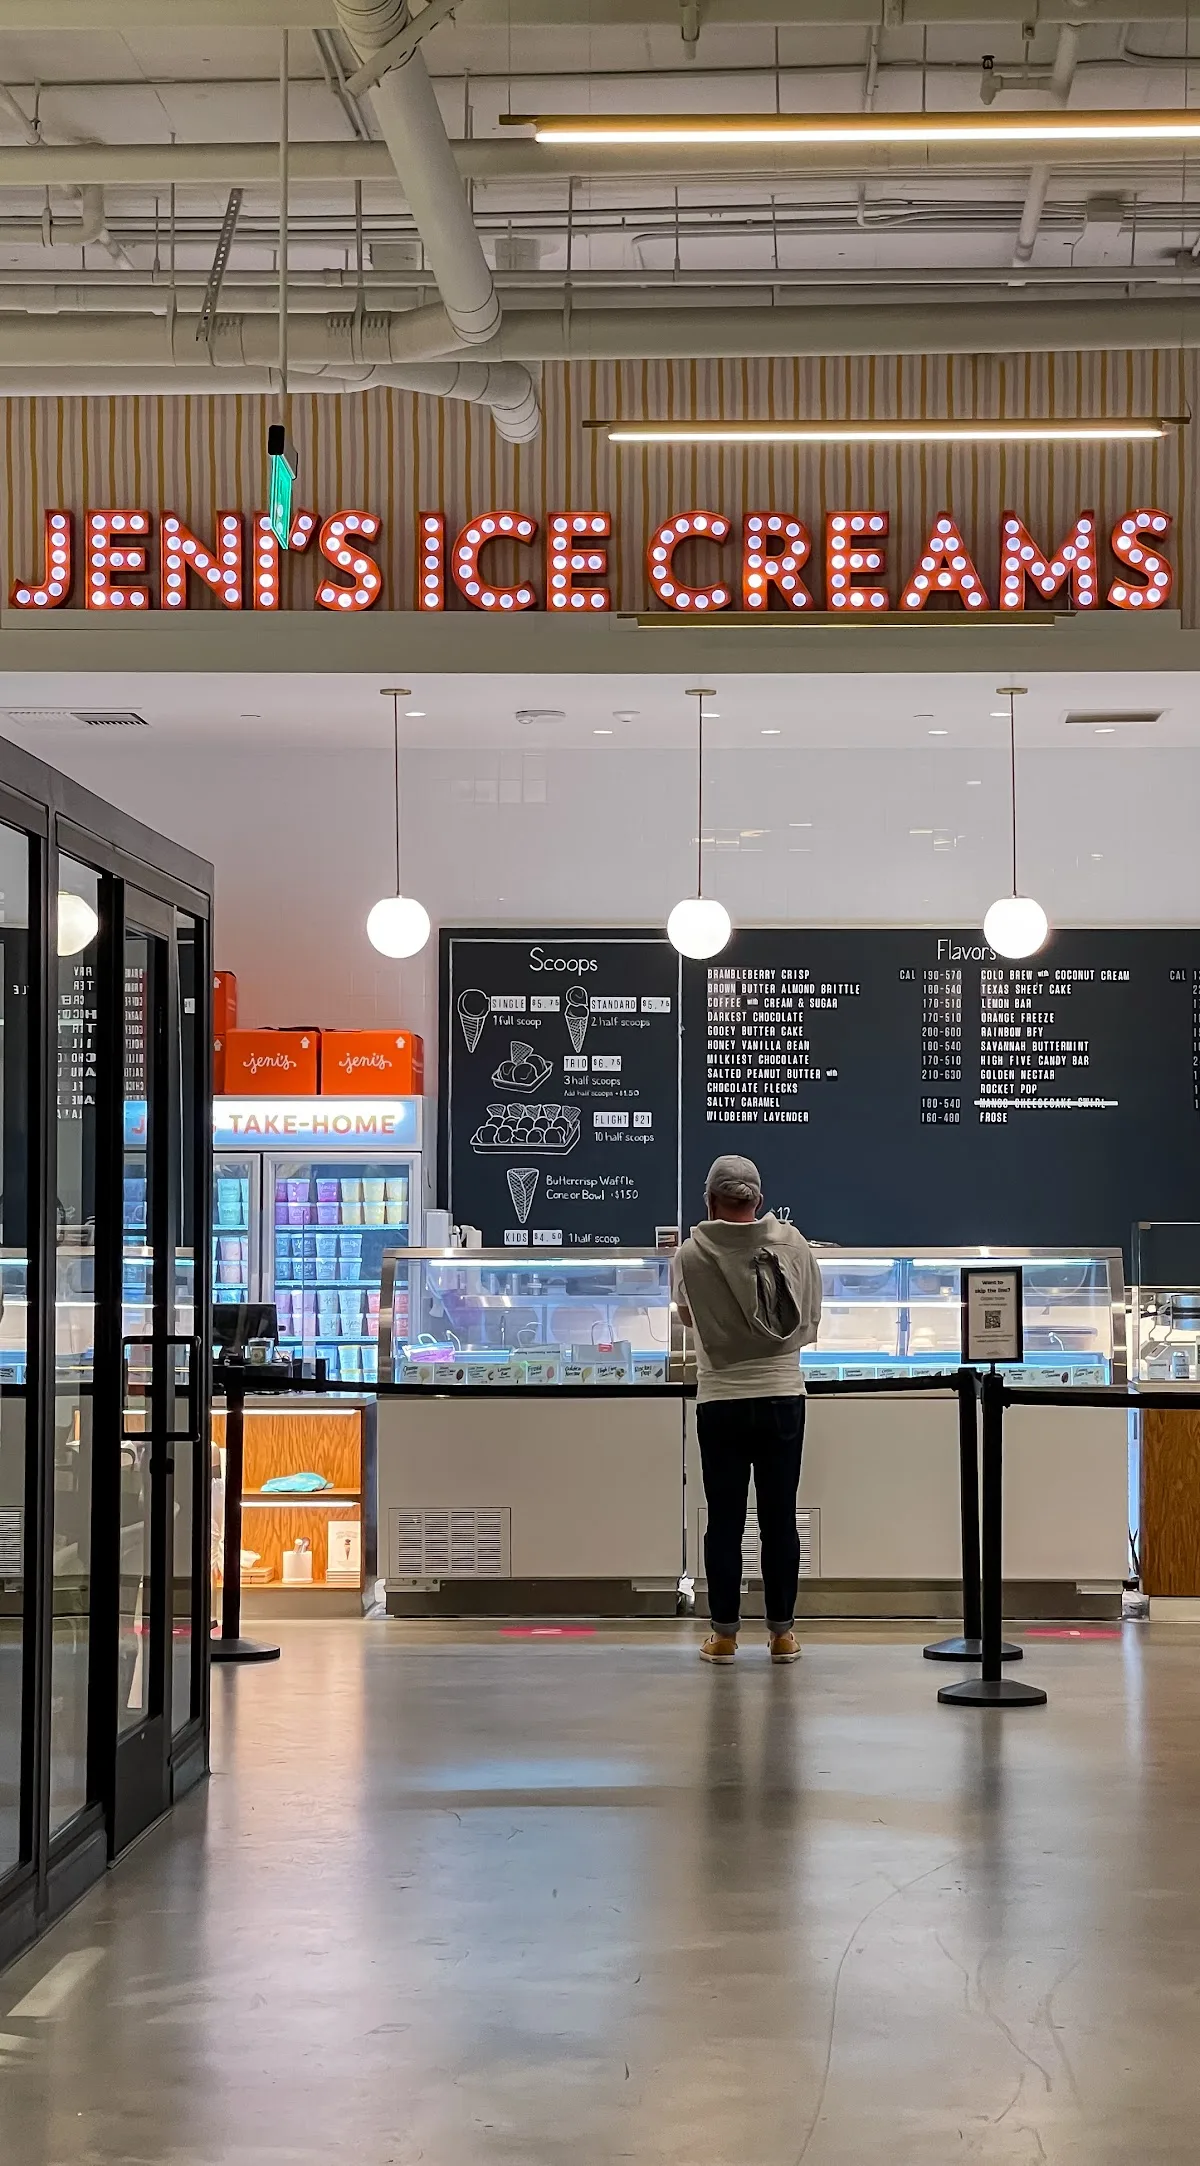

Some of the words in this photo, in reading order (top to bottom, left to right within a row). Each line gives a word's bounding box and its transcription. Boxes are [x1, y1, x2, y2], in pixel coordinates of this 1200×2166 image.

[10, 508, 383, 611] JENI'S
[418, 509, 611, 612] ICE
[647, 509, 1174, 611] CREAMS
[937, 939, 997, 961] Flavors
[529, 946, 598, 976] Scoops
[707, 969, 776, 979] BRAMBLEBERRY
[781, 969, 810, 979] CRISP
[899, 971, 915, 980] CAL
[980, 970, 1004, 980] COLD
[1009, 970, 1033, 980] BREW
[1055, 970, 1095, 980] COCONUT
[1101, 970, 1130, 980] CREAM
[1170, 971, 1186, 980] CAL
[707, 984, 736, 994] BROWN
[741, 984, 776, 994] BUTTER
[781, 984, 815, 994] ALMOND
[821, 984, 860, 994] BRITTLE
[981, 984, 1009, 995] TEXAS
[1015, 984, 1043, 995] SHEET
[1049, 984, 1072, 995] CAKE
[491, 999, 526, 1009] SINGLE
[531, 998, 560, 1009] $5.75
[591, 999, 637, 1010] STANDARD
[642, 999, 671, 1010] $5.75
[707, 998, 741, 1008] COFFEE
[764, 998, 793, 1008] CREAM
[798, 998, 804, 1008] &
[810, 998, 838, 1008] SUGAR
[981, 999, 1009, 1009] LEMON
[1015, 999, 1032, 1009] BAR
[493, 1015, 497, 1025] 1
[499, 1015, 513, 1025] full
[517, 1018, 541, 1028] scoop
[591, 1016, 597, 1026] 2
[599, 1016, 618, 1026] half
[621, 1019, 650, 1028] scoops
[707, 1012, 747, 1022] DARKEST
[753, 1012, 803, 1022] CHOCOLATE
[981, 1013, 1015, 1023] ORANGE
[1021, 1013, 1055, 1023] FREEZE
[707, 1026, 736, 1036] GOOEY
[741, 1026, 776, 1036] BUTTER
[781, 1026, 803, 1036] CAKE
[981, 1027, 1021, 1037] RAINBOW
[1027, 1027, 1043, 1037] BFY
[707, 1040, 736, 1051] HONEY
[741, 1040, 781, 1051] VANILLA
[786, 1040, 810, 1051] BEAN
[980, 1041, 1026, 1051] SAVANNAH
[1032, 1041, 1089, 1051] BUTTERMINT
[243, 1052, 297, 1075] jeni's
[338, 1052, 393, 1075] jeni's
[565, 1058, 587, 1069] TRIO
[593, 1058, 621, 1069] $6.75
[707, 1055, 752, 1065] MILKIEST
[758, 1055, 809, 1065] CHOCOLATE
[980, 1056, 1003, 1066] HIGH
[1009, 1056, 1031, 1066] FIVE
[1038, 1056, 1066, 1066] CANDY
[1072, 1056, 1089, 1066] BAR
[707, 1069, 741, 1080] SALTED
[747, 1069, 781, 1080] PEANUT
[787, 1069, 821, 1080] BUTTER
[980, 1070, 1015, 1080] GOLDEN
[1021, 1070, 1055, 1080] NECTAR
[564, 1075, 570, 1085] 3
[571, 1075, 589, 1085] half
[592, 1078, 620, 1087] scoops
[707, 1083, 758, 1093] CHOCOLATE
[764, 1083, 798, 1093] FLECKS
[980, 1084, 1014, 1094] ROCKET
[1020, 1084, 1037, 1094] POP
[707, 1097, 736, 1107] SALTY
[741, 1097, 780, 1107] CARAMEL
[595, 1114, 627, 1125] FLIGHT
[634, 1114, 650, 1125] $21
[707, 1111, 758, 1122] WILDBERRY
[763, 1111, 809, 1122] LAVENDER
[980, 1112, 1008, 1123] FROSE
[229, 1114, 396, 1135] TAKE-HOME
[594, 1132, 603, 1141] 10
[605, 1132, 624, 1141] half
[625, 1135, 654, 1144] scoops
[546, 1175, 598, 1188] Buttercrisp
[599, 1175, 635, 1185] Waffle
[546, 1189, 569, 1199] Cone
[582, 1189, 604, 1200] Bowl
[505, 1232, 528, 1243] KIDS
[534, 1232, 563, 1243] $4.50
[569, 1233, 573, 1242] 1
[574, 1233, 592, 1242] half
[595, 1235, 620, 1244] scoop
